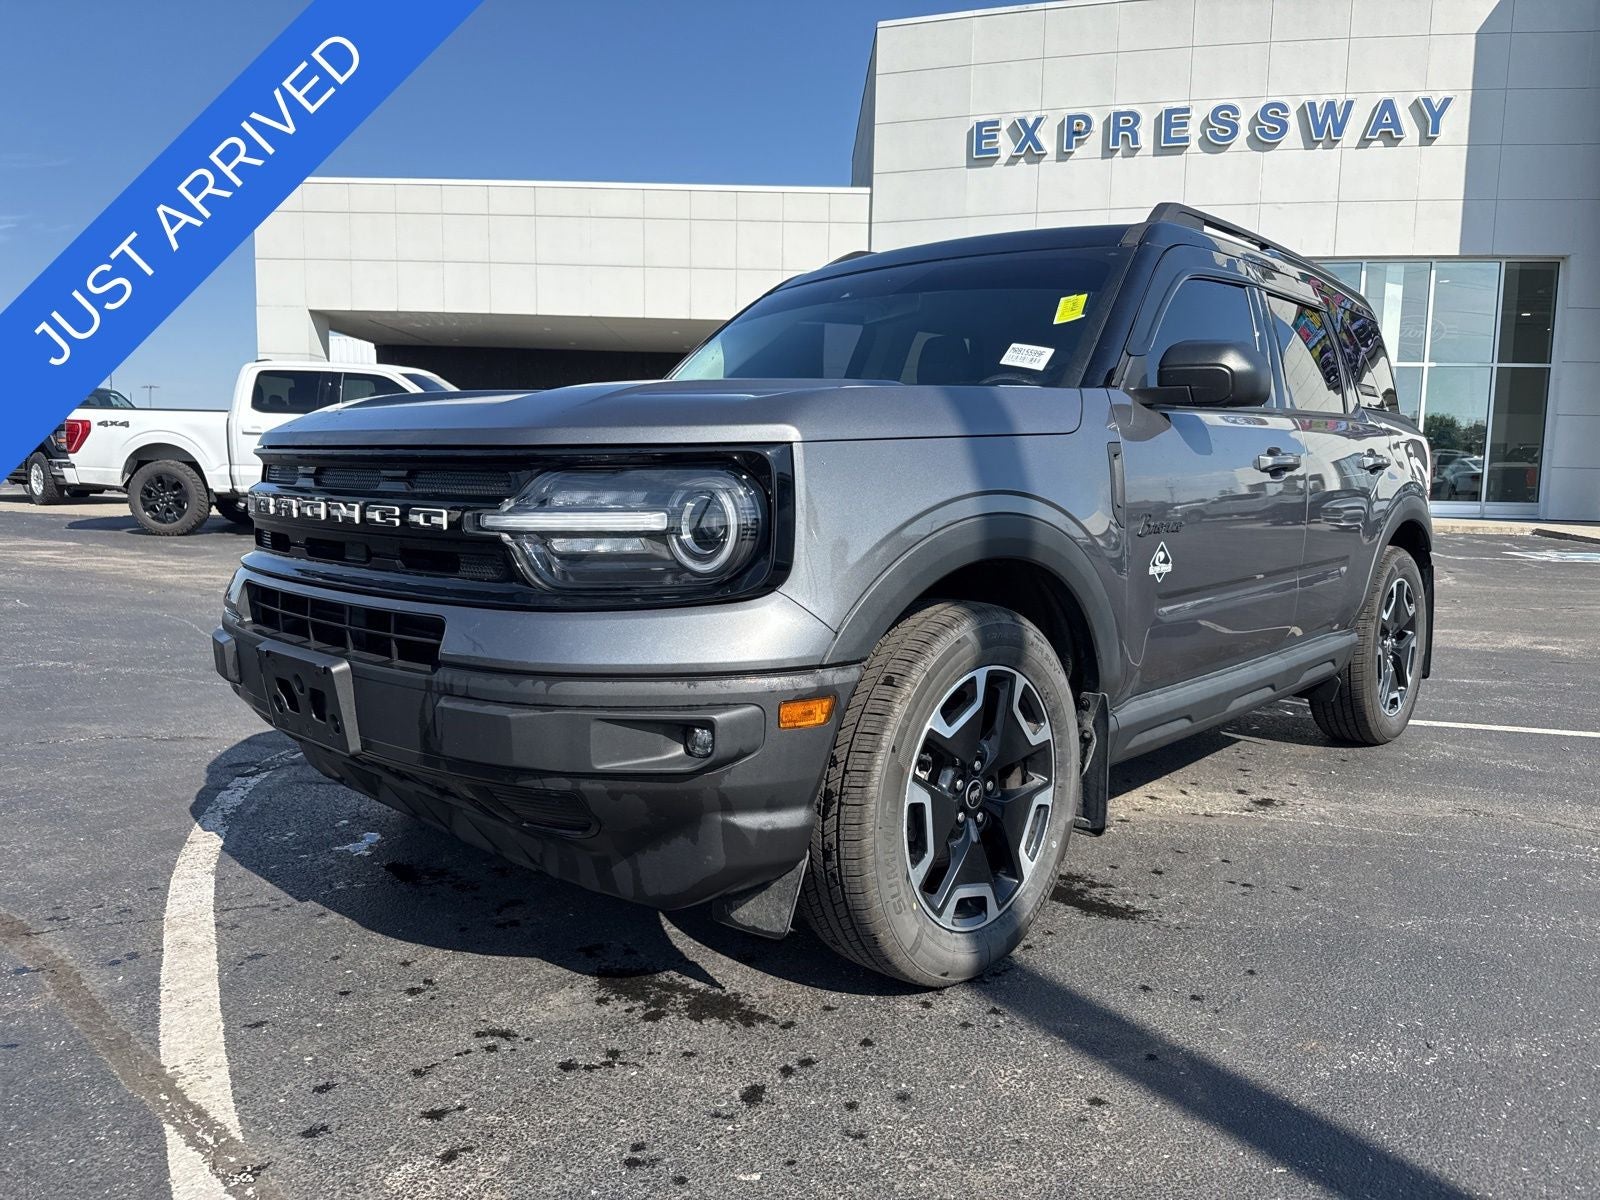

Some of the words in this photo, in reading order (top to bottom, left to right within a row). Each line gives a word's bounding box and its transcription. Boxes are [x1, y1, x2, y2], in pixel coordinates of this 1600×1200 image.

[973, 96, 1456, 158] EXPRESSWAY
[250, 495, 448, 531] BRONCO
[1136, 513, 1184, 538] Bronco
